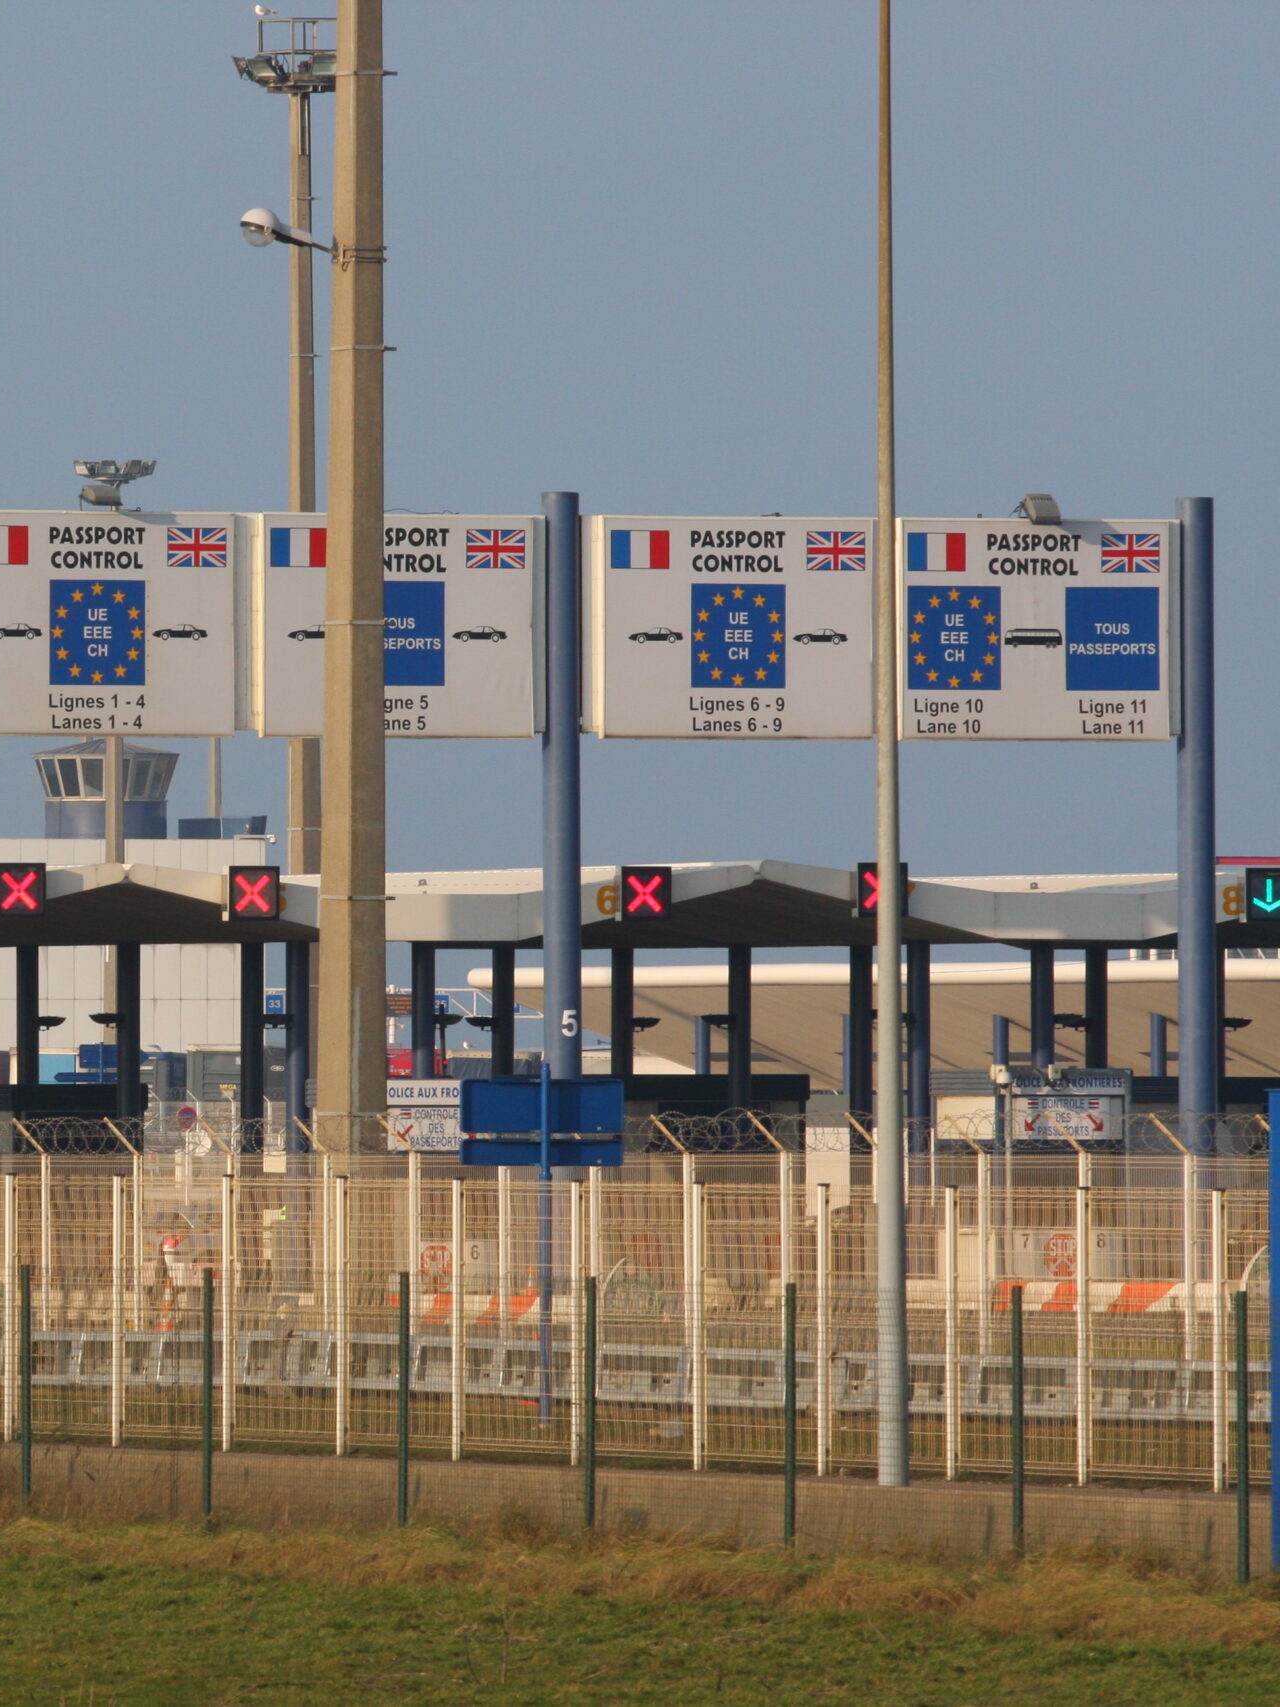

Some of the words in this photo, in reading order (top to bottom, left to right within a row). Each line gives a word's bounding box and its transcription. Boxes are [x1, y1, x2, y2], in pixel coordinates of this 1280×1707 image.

[49, 526, 146, 545] PASSPORT
[384, 527, 450, 547] SPORT
[690, 530, 786, 548] PASSPORT
[987, 533, 1082, 552] PASSPORT
[50, 551, 143, 569] CONTROL
[383, 553, 447, 573] NTROL
[692, 554, 783, 572] CONTROL
[988, 557, 1079, 576] CONTROL
[87, 608, 108, 621] UE
[729, 612, 749, 625] UE
[944, 614, 965, 627] UE
[83, 626, 113, 639] EEE
[724, 629, 753, 642] EEE
[1095, 623, 1130, 635] TOUS
[384, 638, 442, 650] SEPORTS
[940, 631, 969, 644] EEE
[87, 644, 108, 657] CH
[728, 647, 749, 660] CH
[944, 649, 965, 662] CH
[1069, 643, 1157, 655] PASSEPORTS
[48, 693, 105, 712] Lignes
[111, 694, 118, 708] 1
[136, 694, 146, 708] 4
[384, 697, 414, 713] gne
[420, 695, 429, 710] 5
[689, 696, 745, 715] Lignes
[750, 697, 760, 711] 6
[775, 697, 785, 711] 9
[914, 698, 959, 716] Ligne
[965, 699, 984, 713] 10
[1079, 699, 1124, 717] Ligne
[1131, 700, 1147, 714] 11
[51, 714, 102, 729] Lanes
[108, 715, 115, 729] 1
[133, 715, 143, 729] 4
[384, 718, 411, 731] ane
[417, 716, 426, 731] 5
[692, 717, 742, 732] Lanes
[747, 717, 757, 732] 6
[773, 717, 783, 732] 9
[917, 719, 957, 734] Lane
[963, 719, 981, 734] 10
[1082, 720, 1122, 735] Lane
[1129, 720, 1144, 735] 11
[596, 885, 618, 915] 6
[1222, 886, 1245, 916] 8
[268, 1000, 281, 1008] 33
[561, 1009, 578, 1037] 5
[388, 1087, 414, 1098] OLICE
[418, 1087, 438, 1098] AUX
[414, 1108, 458, 1120] CONTROLE
[1056, 1112, 1072, 1122] DES
[429, 1123, 445, 1133] DES
[1037, 1126, 1090, 1137] PASSORTS
[1097, 1233, 1106, 1248] 8
[471, 1245, 479, 1260] 6
